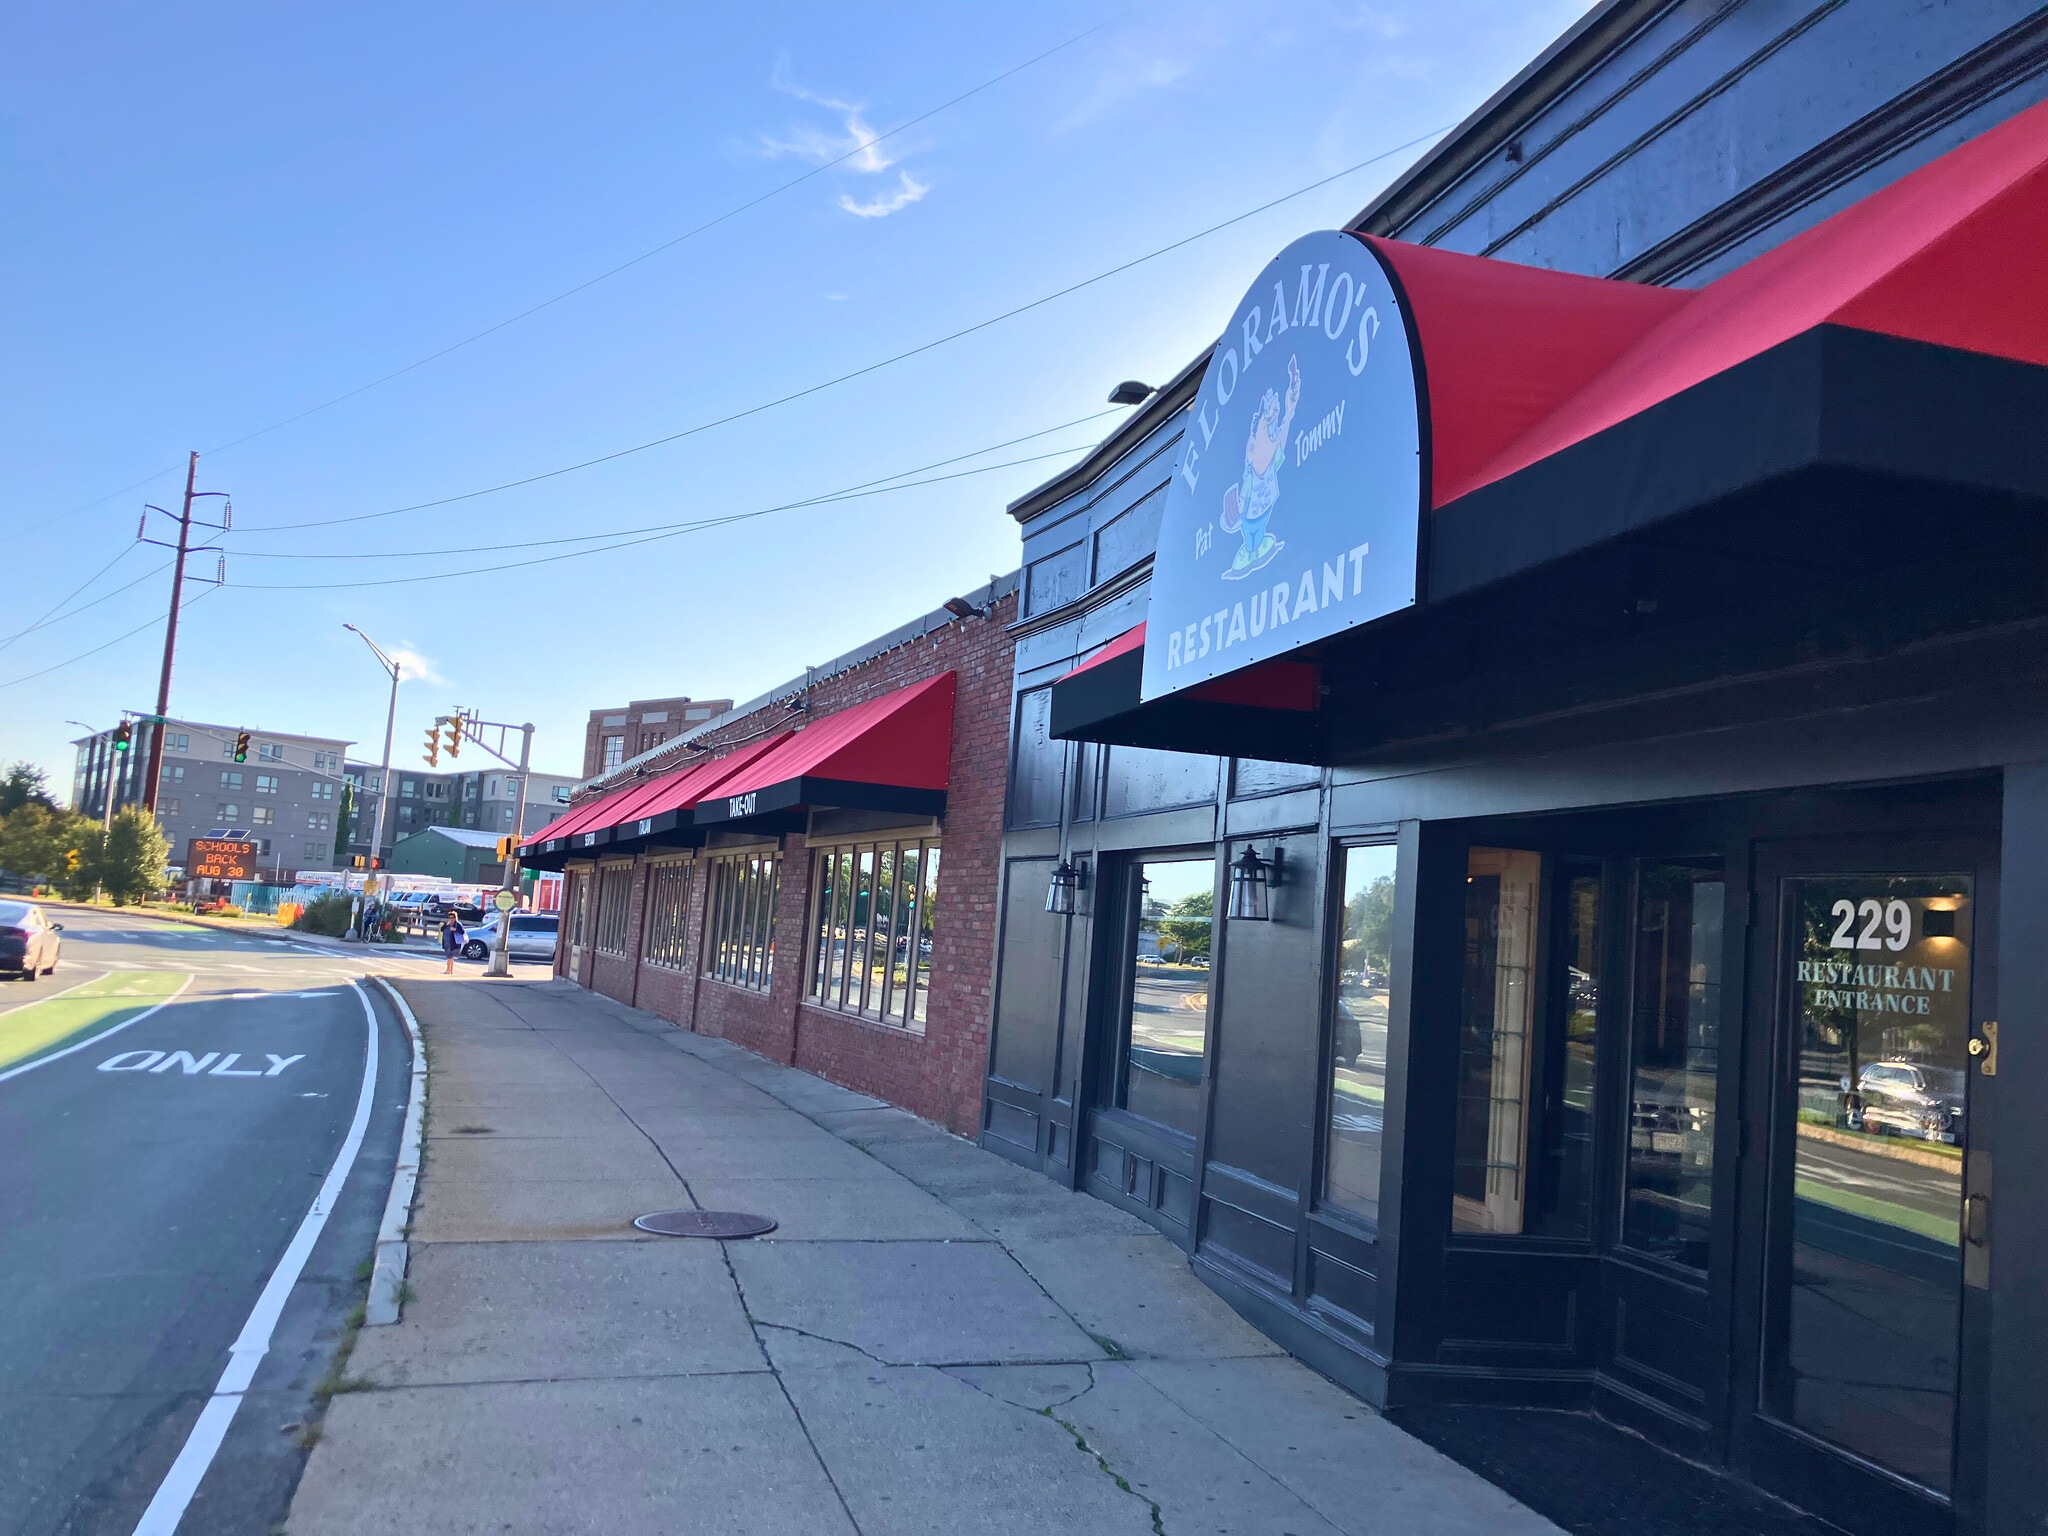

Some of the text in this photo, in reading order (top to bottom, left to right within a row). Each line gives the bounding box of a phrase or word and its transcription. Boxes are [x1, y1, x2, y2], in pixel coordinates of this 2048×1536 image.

[1181, 262, 1381, 496] FLORAMO'S
[1294, 399, 1346, 468] Tommy
[1194, 520, 1214, 561] Pat
[1166, 541, 1370, 671] RESTAURANT
[729, 792, 757, 818] TAKE-OUT
[196, 841, 250, 854] SCHOOLS
[205, 853, 238, 865] BACK
[196, 864, 244, 877] AUG 30
[1829, 898, 1912, 952] 229
[1796, 959, 1956, 993] RESTAURANT
[1813, 987, 1930, 1015] ENTRANCE
[96, 1049, 307, 1077] ONLY
